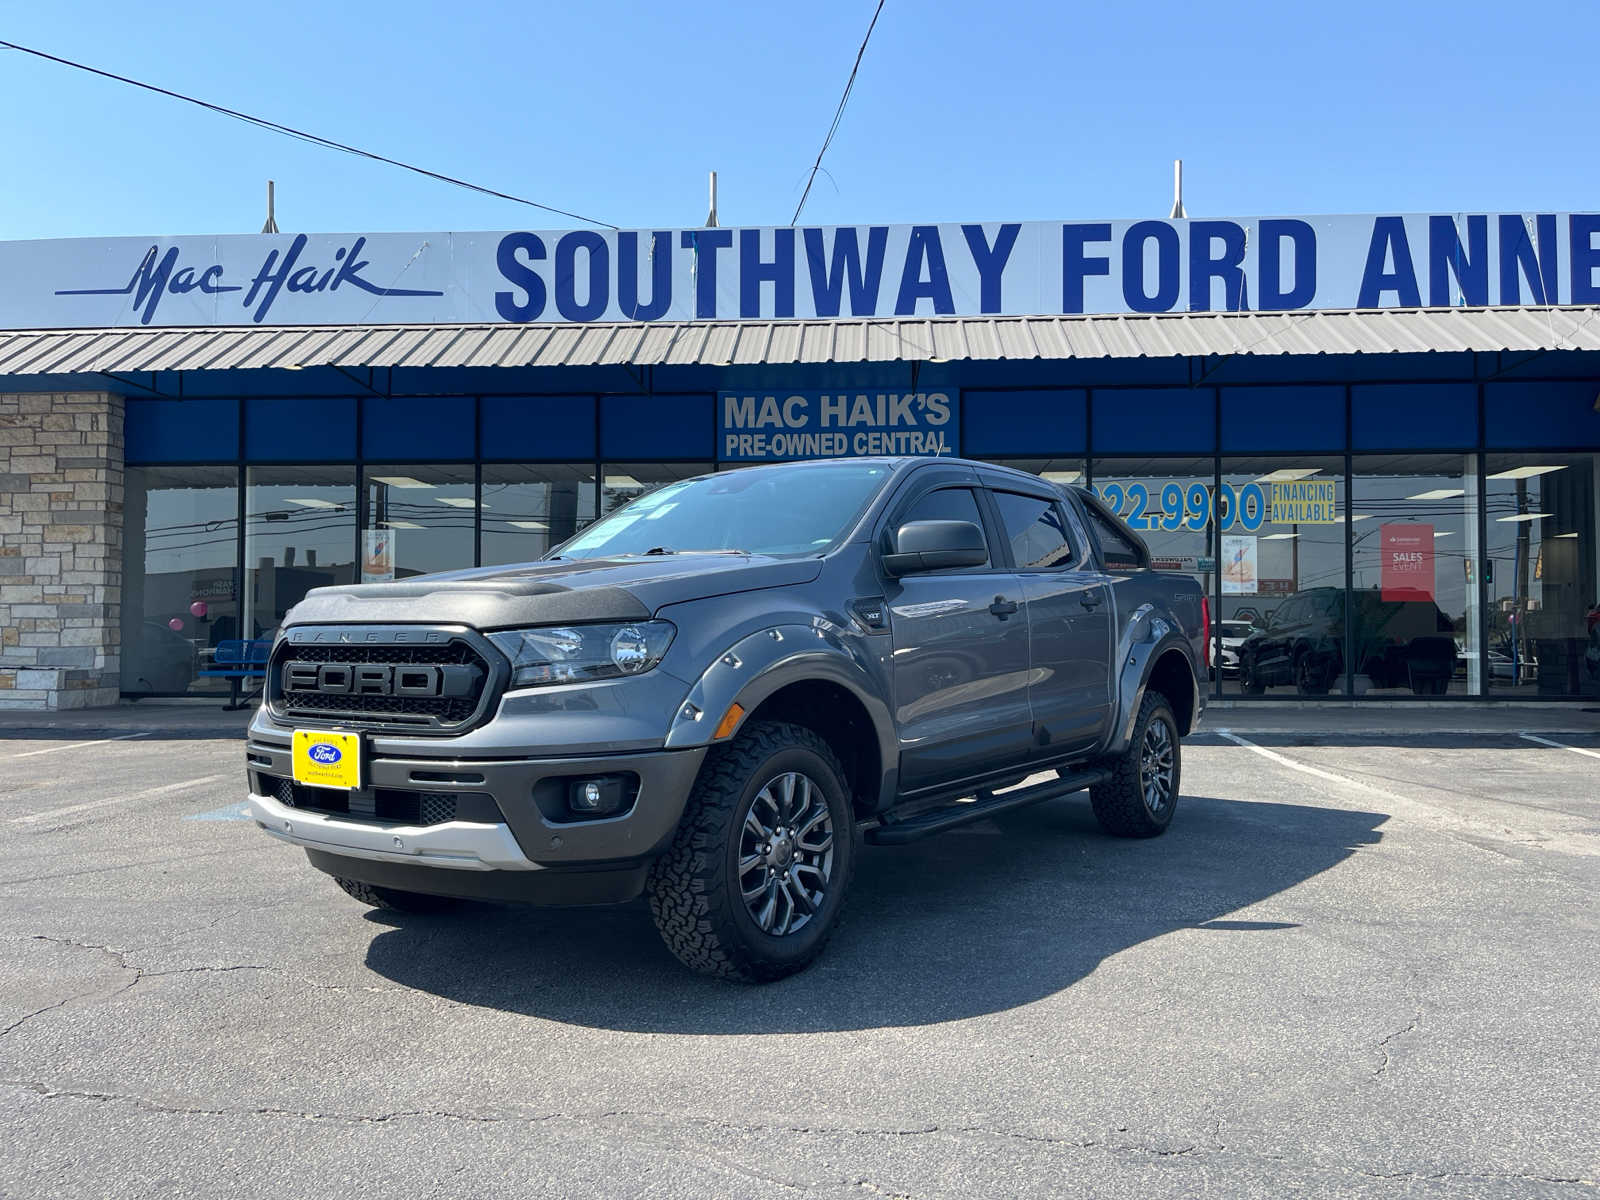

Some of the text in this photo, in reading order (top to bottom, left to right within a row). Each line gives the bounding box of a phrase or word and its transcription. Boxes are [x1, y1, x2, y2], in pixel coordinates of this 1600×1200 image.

[55, 234, 444, 325] Mac Haik
[495, 213, 1600, 323] SOUTHWAY FORD ANNE
[724, 392, 951, 429] MAC HAIK'S
[726, 431, 952, 457] PRE-OWNED CENTRAL
[1272, 484, 1333, 502] FINANCING
[1273, 502, 1335, 522] AVAILABLE
[1392, 552, 1423, 562] SALES
[292, 631, 442, 644] RANGER
[282, 661, 440, 697] FORD
[313, 745, 337, 762] Ford
